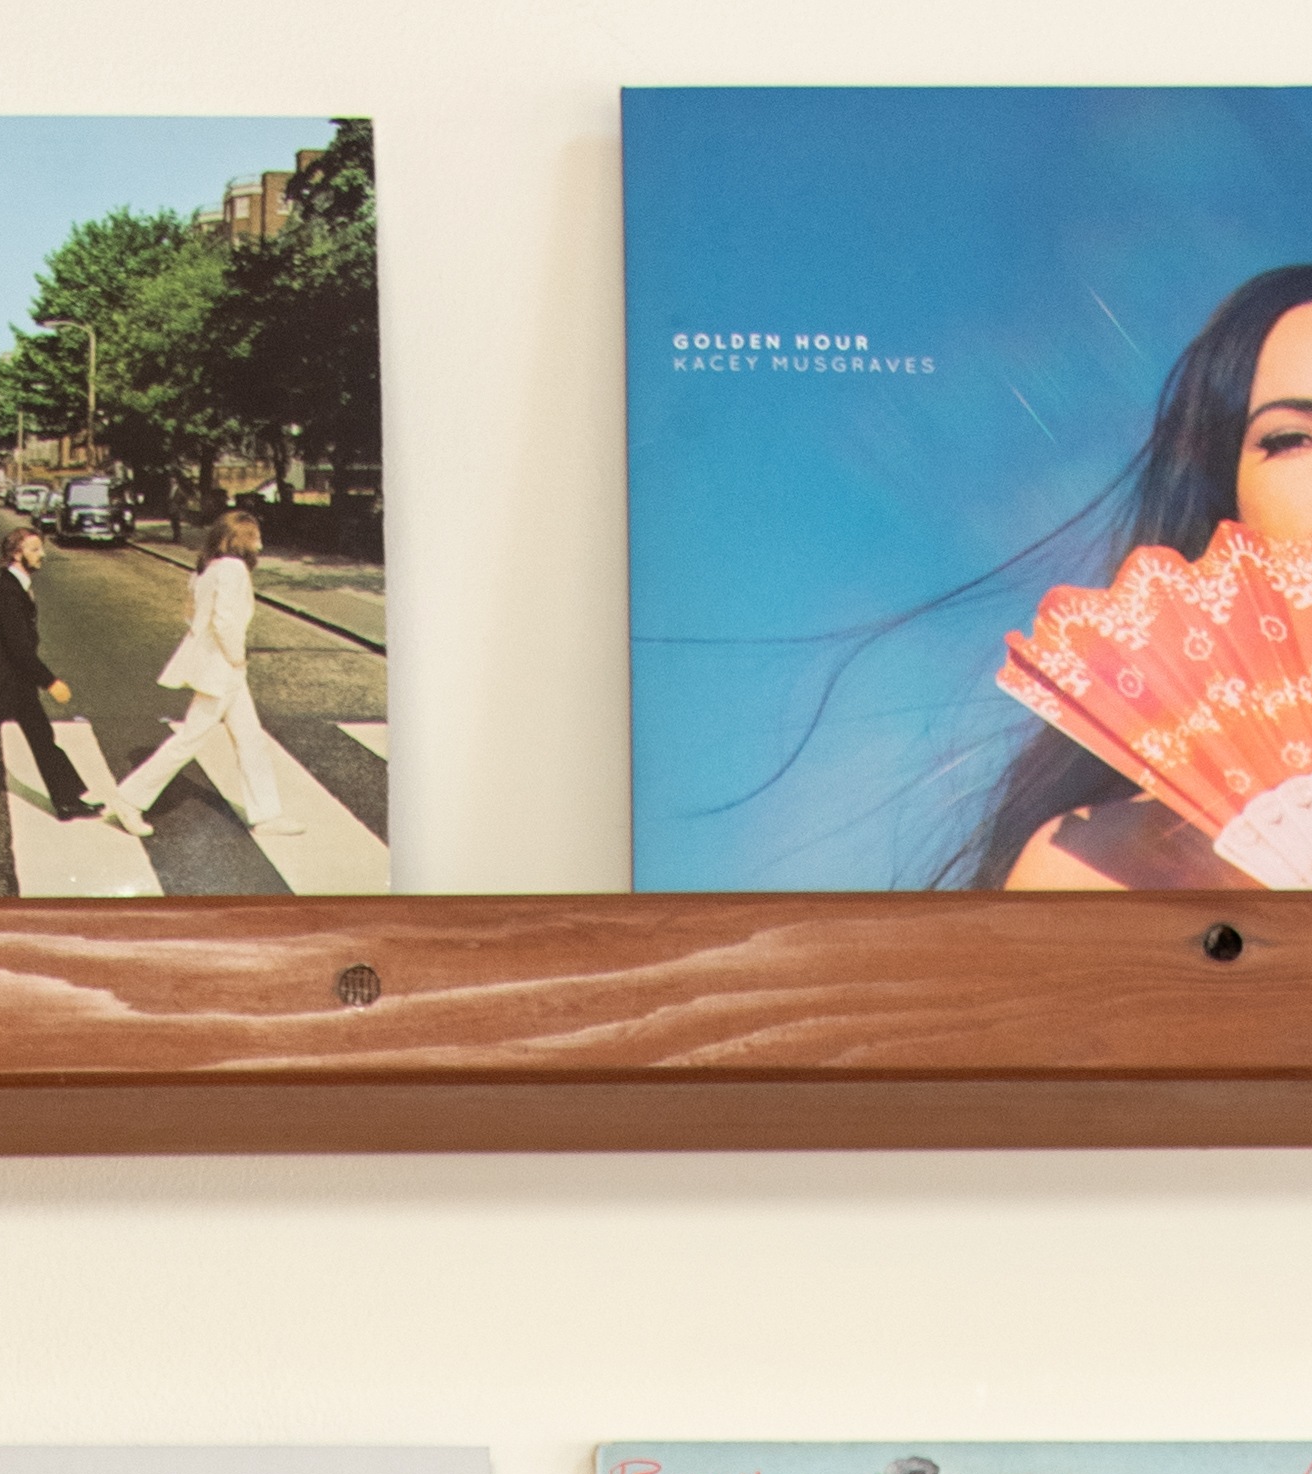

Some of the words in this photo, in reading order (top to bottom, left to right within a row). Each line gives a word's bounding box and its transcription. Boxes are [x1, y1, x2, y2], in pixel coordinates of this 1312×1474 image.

[673, 333, 781, 350] GOLDEN
[795, 334, 869, 351] HOUR
[673, 355, 759, 371] KACEY
[772, 355, 936, 374] MUSGRAVES
